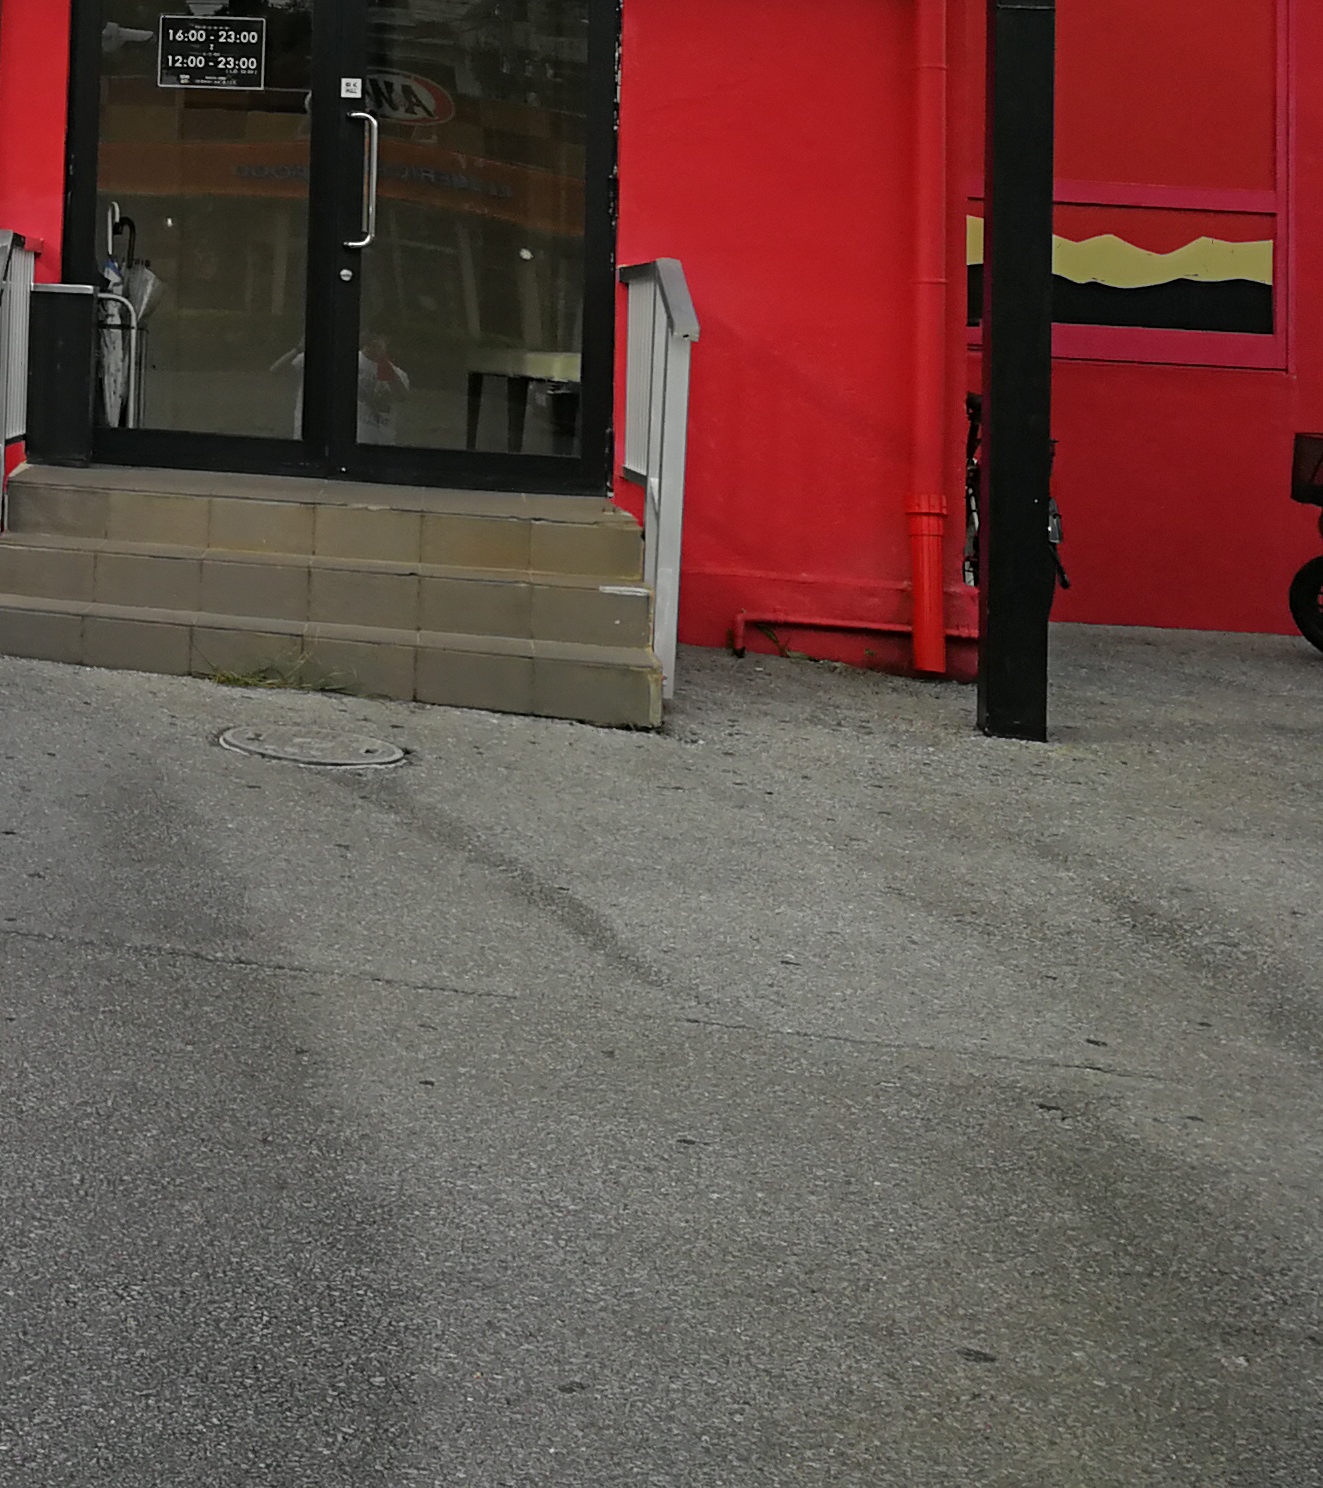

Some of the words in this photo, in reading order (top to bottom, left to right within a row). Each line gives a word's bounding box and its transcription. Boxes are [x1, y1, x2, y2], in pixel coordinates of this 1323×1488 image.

[168, 28, 207, 42] 16:00
[218, 30, 258, 43] 23:00
[167, 55, 206, 68] 12:00
[217, 56, 257, 69] 23:00
